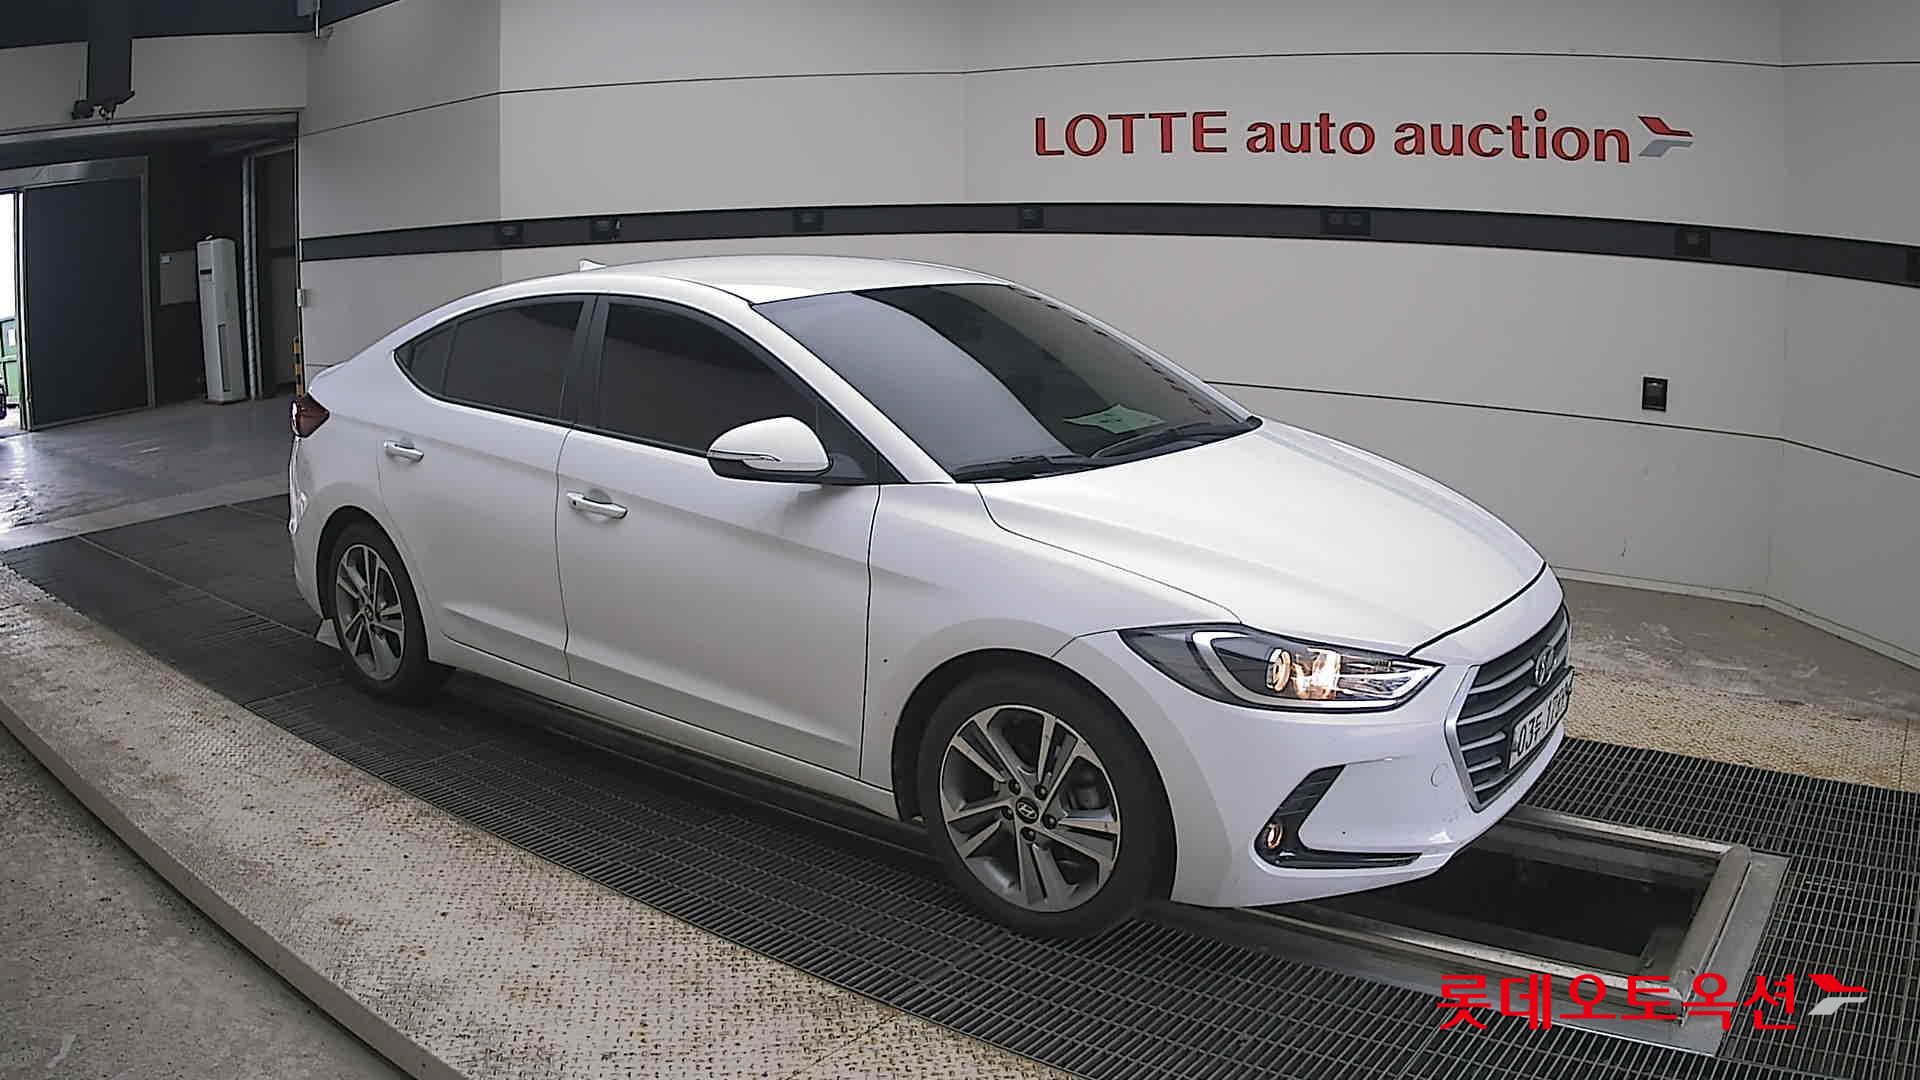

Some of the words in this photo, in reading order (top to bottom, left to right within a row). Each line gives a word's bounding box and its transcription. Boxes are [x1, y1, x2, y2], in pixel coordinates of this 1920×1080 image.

[1035, 111, 1228, 157] LOTTE
[1246, 112, 1376, 155] auto
[1394, 108, 1630, 163] auction
